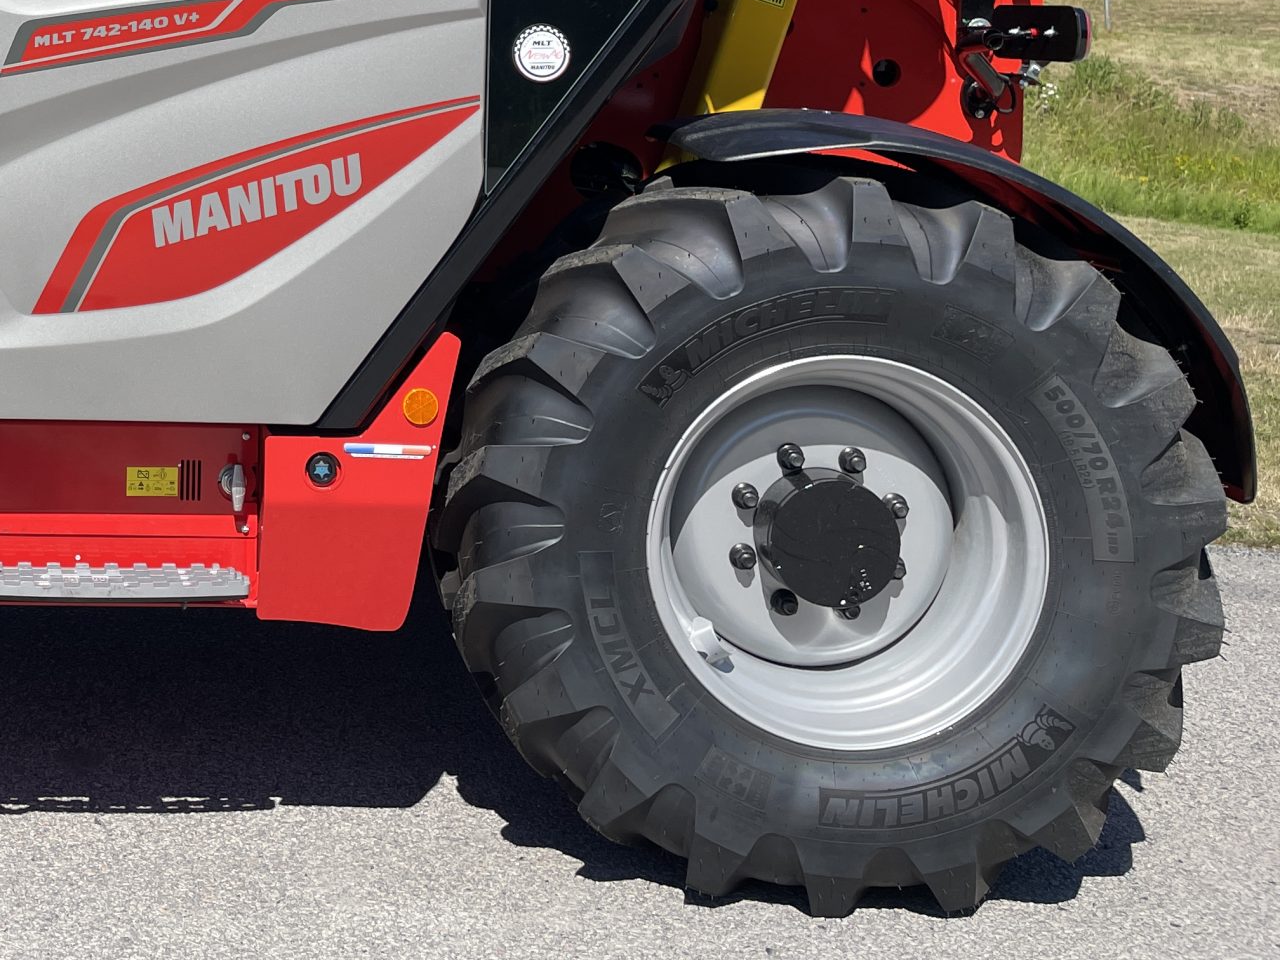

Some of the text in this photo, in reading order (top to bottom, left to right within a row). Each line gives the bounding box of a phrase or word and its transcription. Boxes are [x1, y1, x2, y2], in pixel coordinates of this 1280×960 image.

[34, 12, 200, 47] MLT 742-140 V+
[151, 152, 363, 248] MANITOU
[685, 289, 893, 369] MICHELIN
[1043, 385, 1109, 472] 500/70
[1096, 477, 1126, 528] R24
[589, 590, 656, 704] XMCL
[821, 741, 1032, 827] MICHELIN
